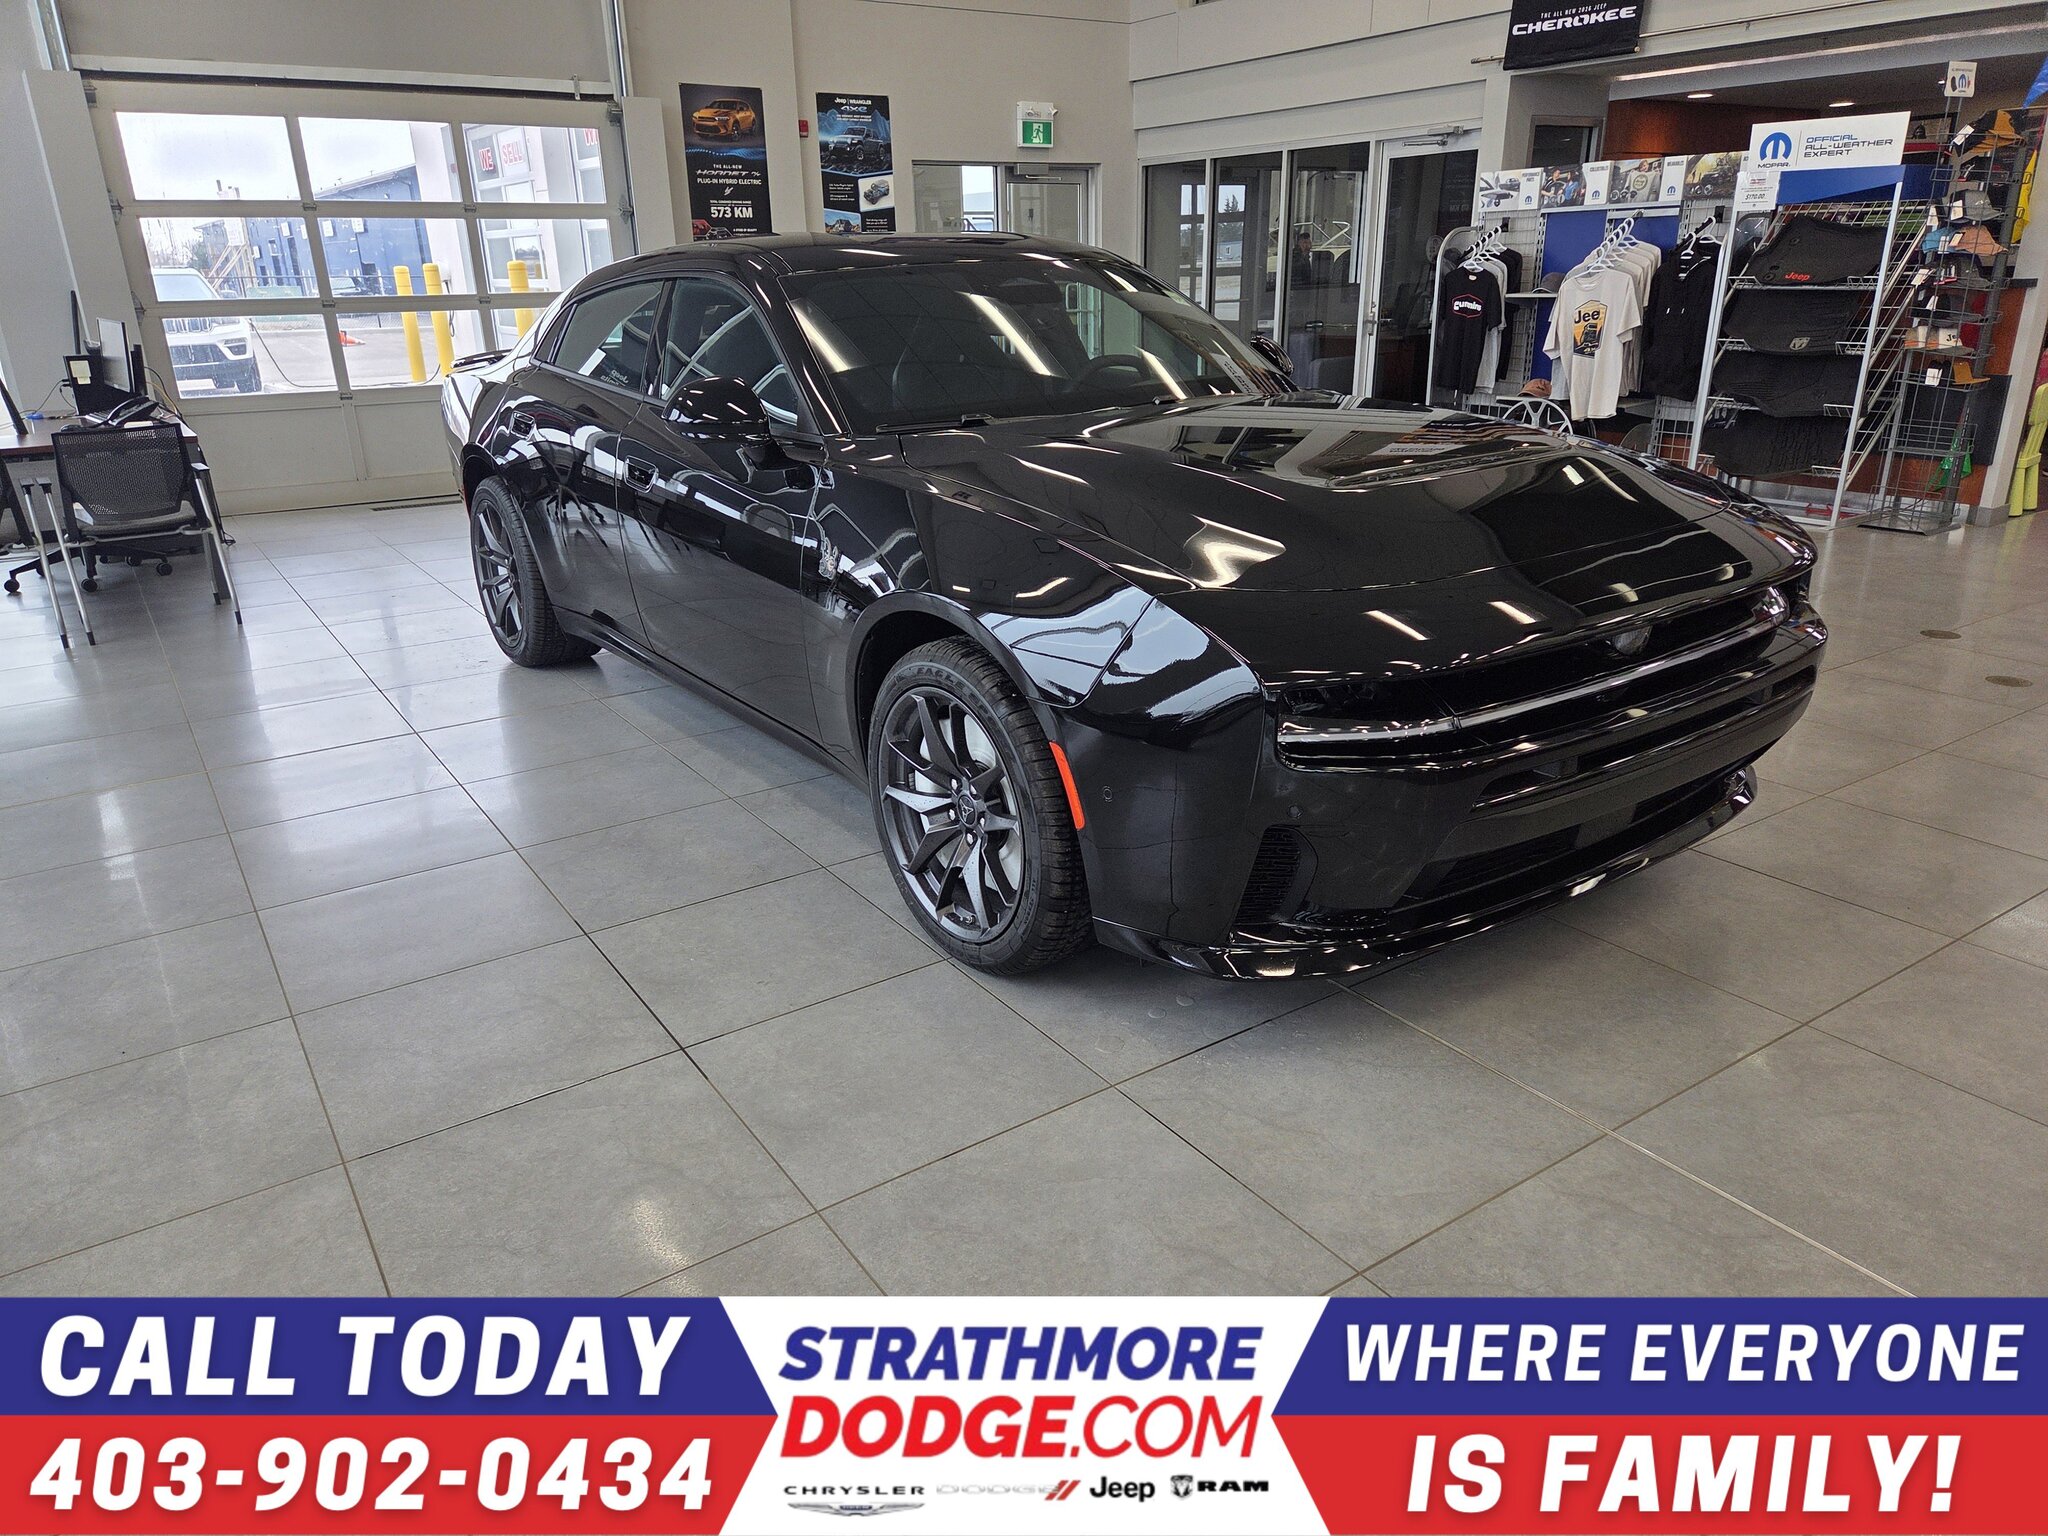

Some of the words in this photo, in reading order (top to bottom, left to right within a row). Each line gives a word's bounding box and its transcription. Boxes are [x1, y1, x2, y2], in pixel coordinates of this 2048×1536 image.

[1553, 9, 1563, 17] ALL
[1565, 8, 1576, 16] NEW
[1578, 5, 1592, 13] 2026
[1593, 3, 1607, 11] JEEP
[1512, 6, 1637, 36] CHEROKEE
[1804, 138, 1894, 151] ALL-WEATHER
[1806, 134, 1858, 144] OFFICIAL
[479, 147, 496, 171] WE
[502, 141, 524, 166] SELL
[1803, 149, 1853, 158] EXPERT
[711, 207, 732, 218] 573
[734, 207, 753, 219] KM
[1785, 272, 1810, 281] Jeep
